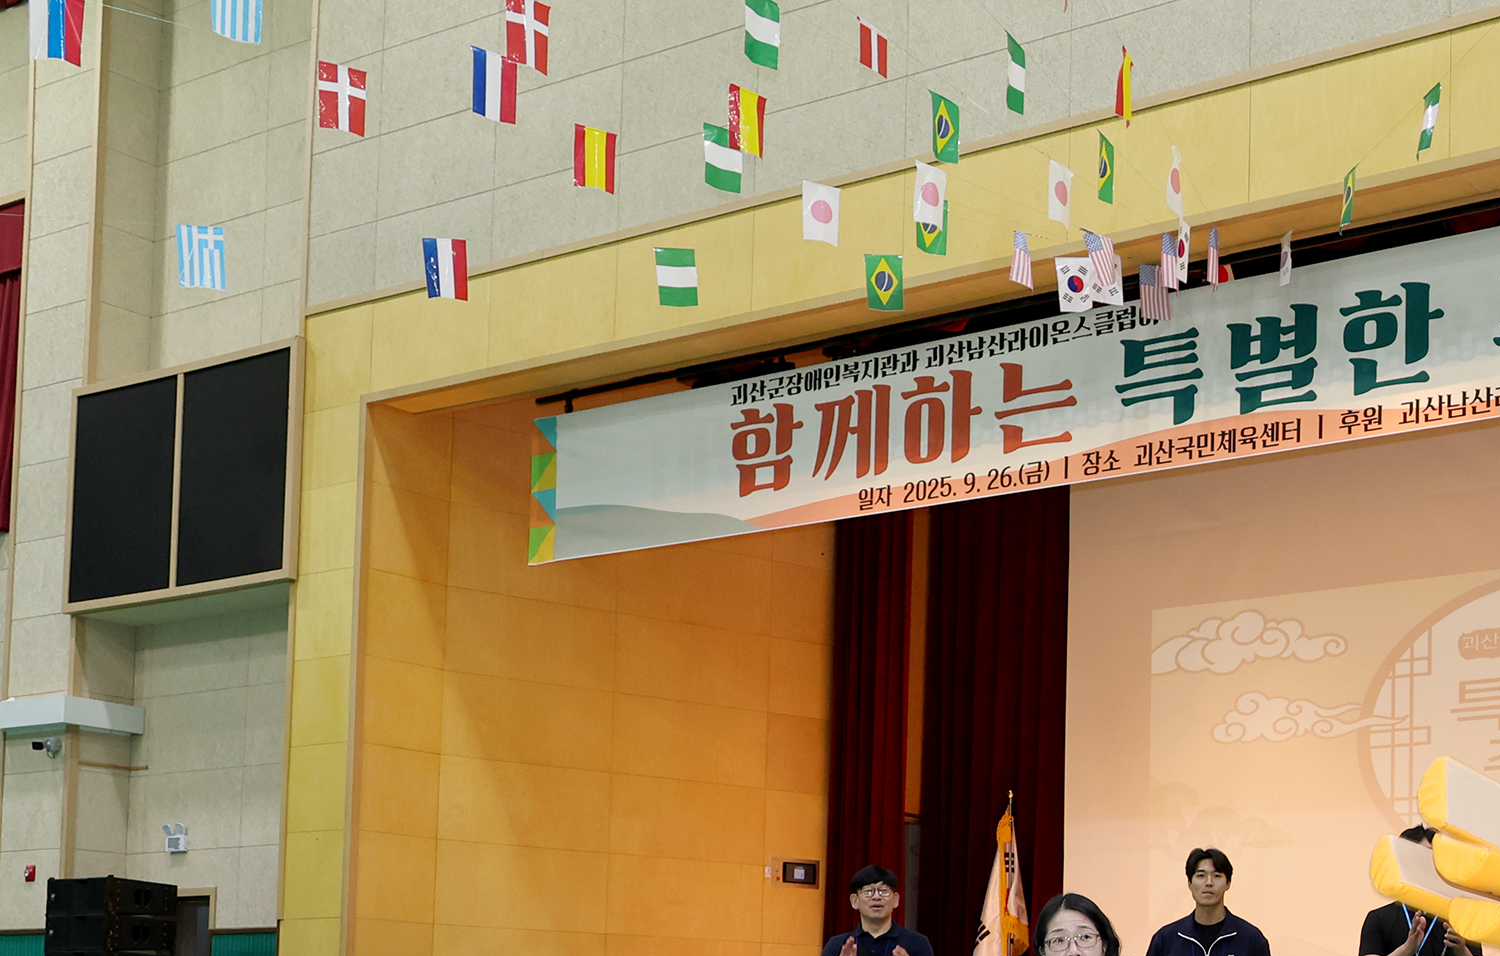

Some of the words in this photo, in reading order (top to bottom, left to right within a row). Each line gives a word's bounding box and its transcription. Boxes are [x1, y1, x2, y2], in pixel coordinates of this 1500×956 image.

[730, 349, 920, 407] 괴산군장애인복지관과
[730, 361, 1078, 498] 함께하는
[1113, 280, 1445, 426] 특별한
[858, 484, 893, 511] 일자
[902, 475, 957, 504] 2025.
[963, 471, 981, 495] 9.
[986, 459, 1050, 490] 26.(금)
[1081, 450, 1122, 476] 장소
[1133, 417, 1302, 467] 괴산국민체육센터
[1338, 405, 1384, 435] 후원
